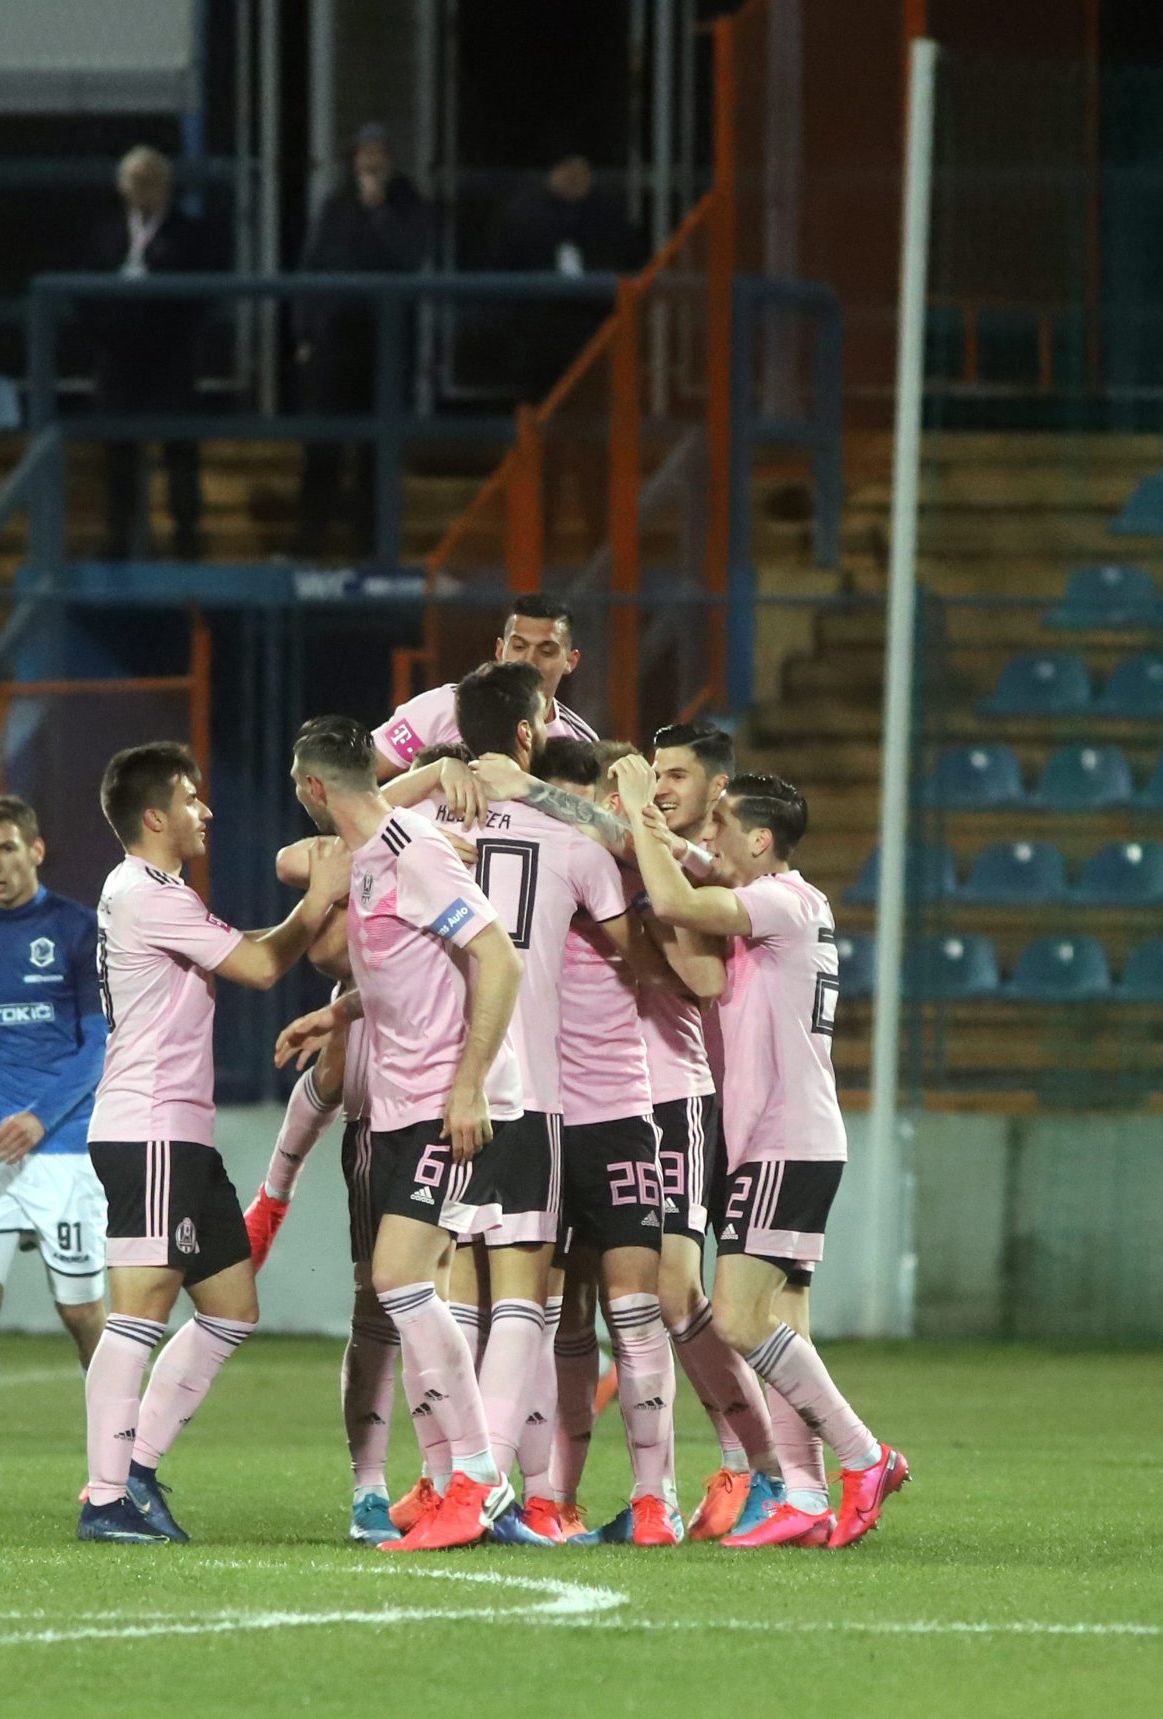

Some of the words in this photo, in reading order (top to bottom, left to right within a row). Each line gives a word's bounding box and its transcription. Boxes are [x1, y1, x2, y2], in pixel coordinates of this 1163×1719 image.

[447, 906, 469, 928] Auto
[414, 1144, 451, 1188] 6
[606, 1160, 661, 1206] 26
[725, 1176, 753, 1219] 2
[57, 1221, 82, 1252] 91
